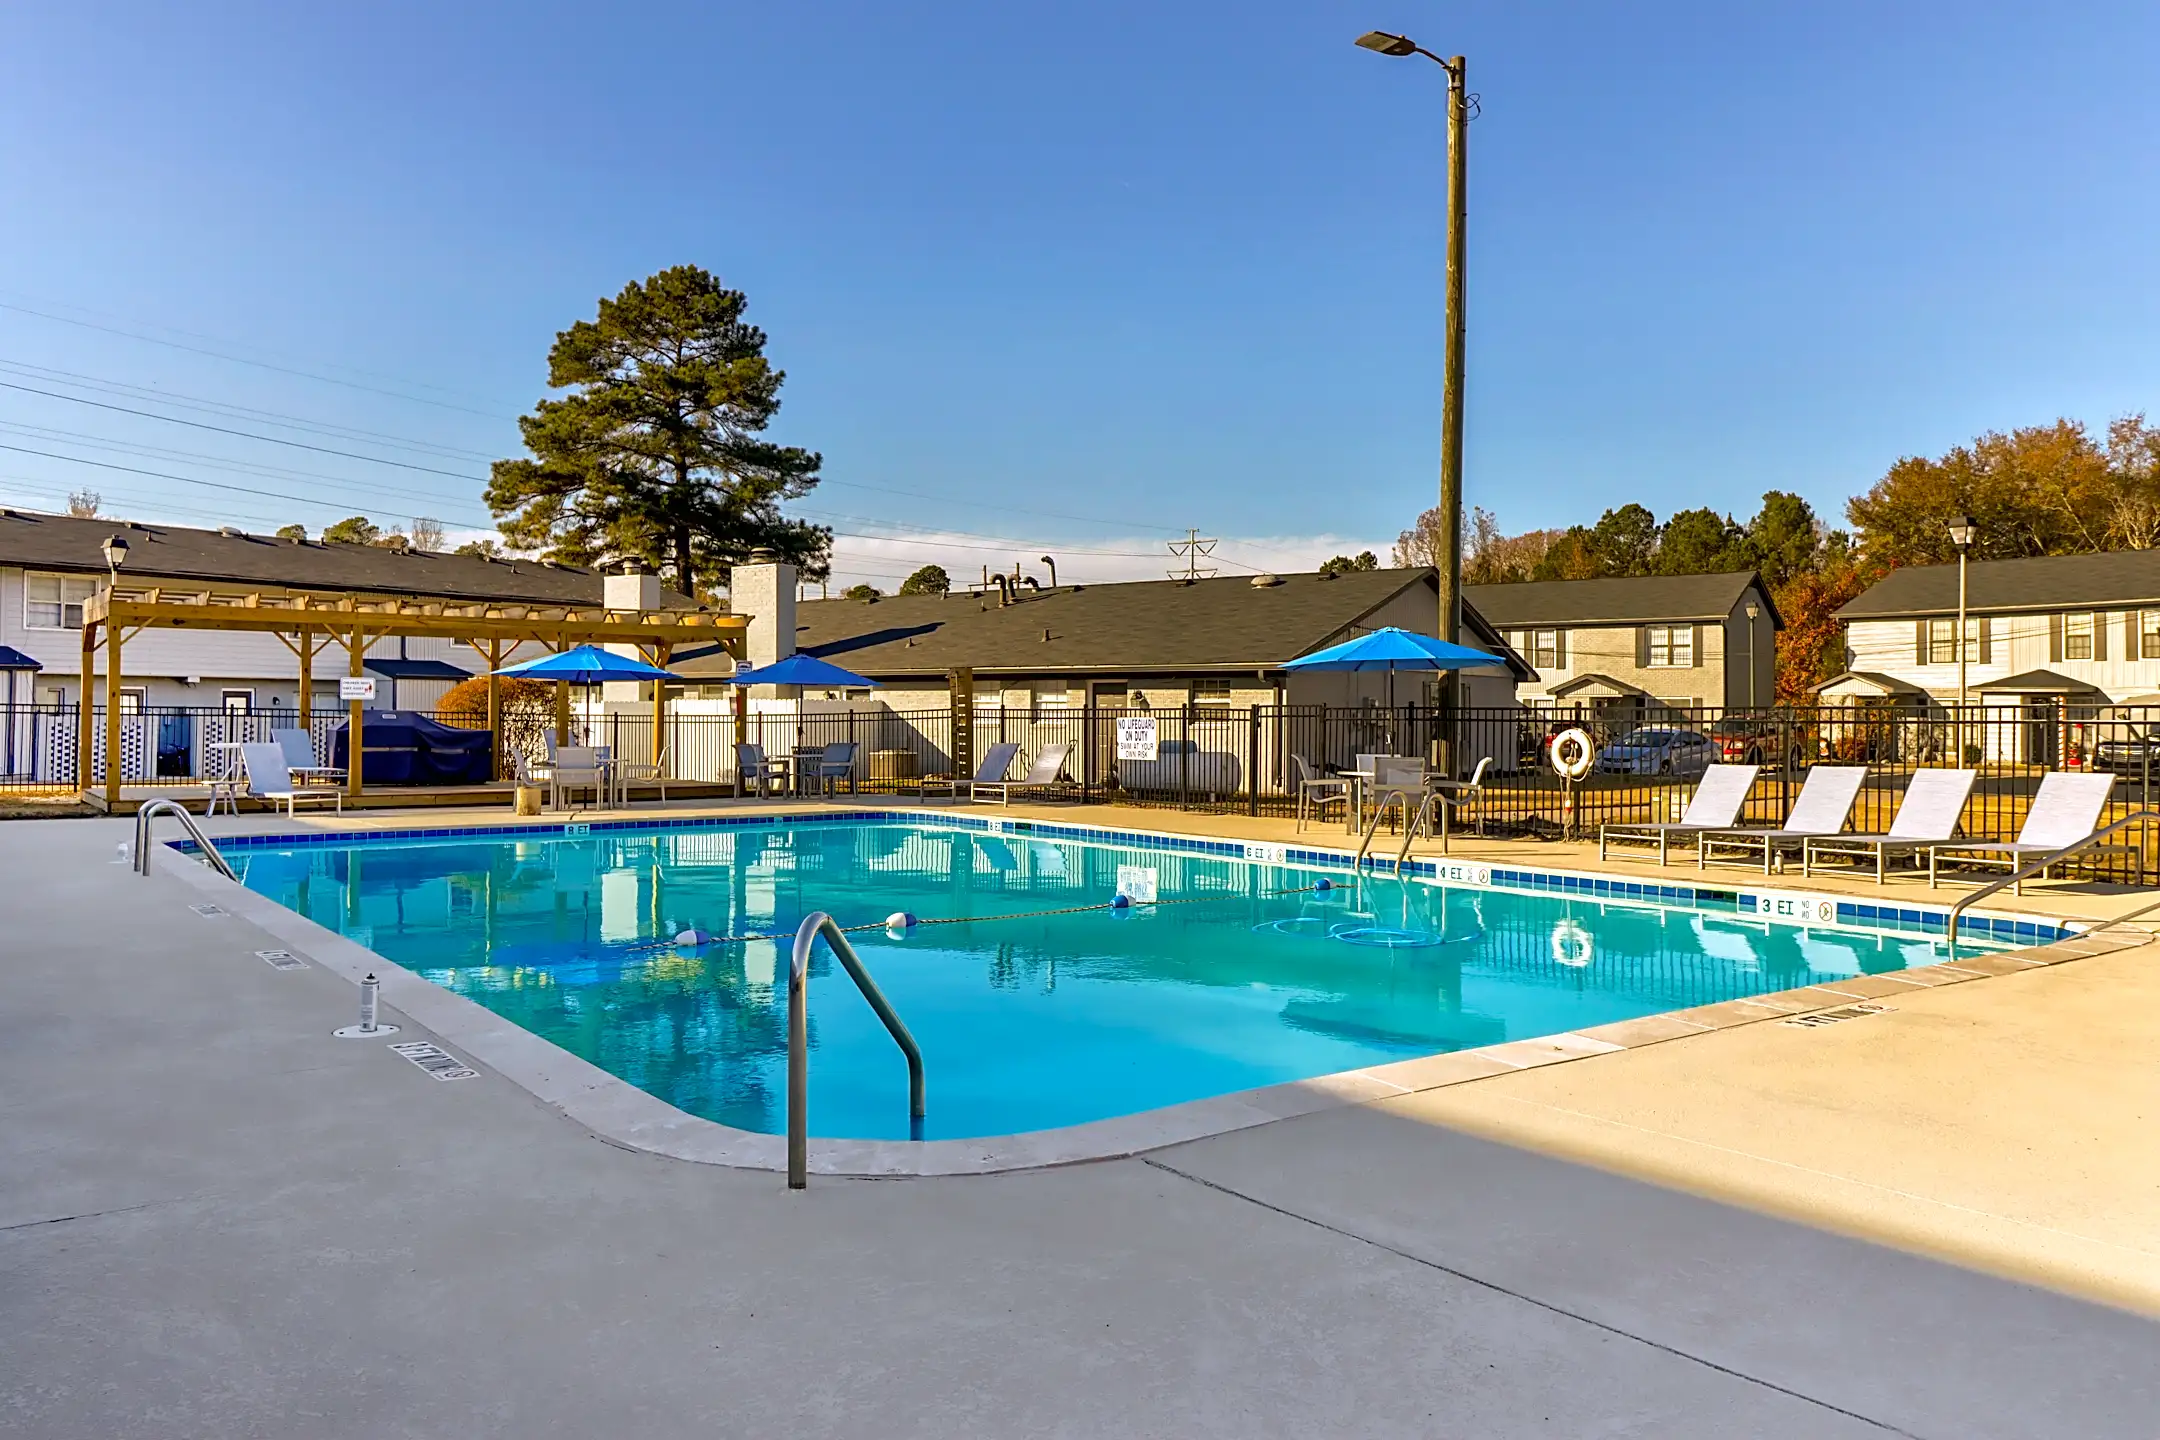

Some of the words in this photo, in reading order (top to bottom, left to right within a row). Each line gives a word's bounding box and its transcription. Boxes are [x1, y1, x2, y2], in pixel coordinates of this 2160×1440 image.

[1117, 719, 1125, 729] NO
[1127, 719, 1155, 730] LIFEGUARD
[1125, 731, 1132, 741] ON
[1135, 731, 1148, 741] DUTY
[1141, 742, 1153, 750] YOUR
[1126, 750, 1136, 758] OWN
[1137, 750, 1147, 758] RISK
[1762, 899, 1771, 912] 3
